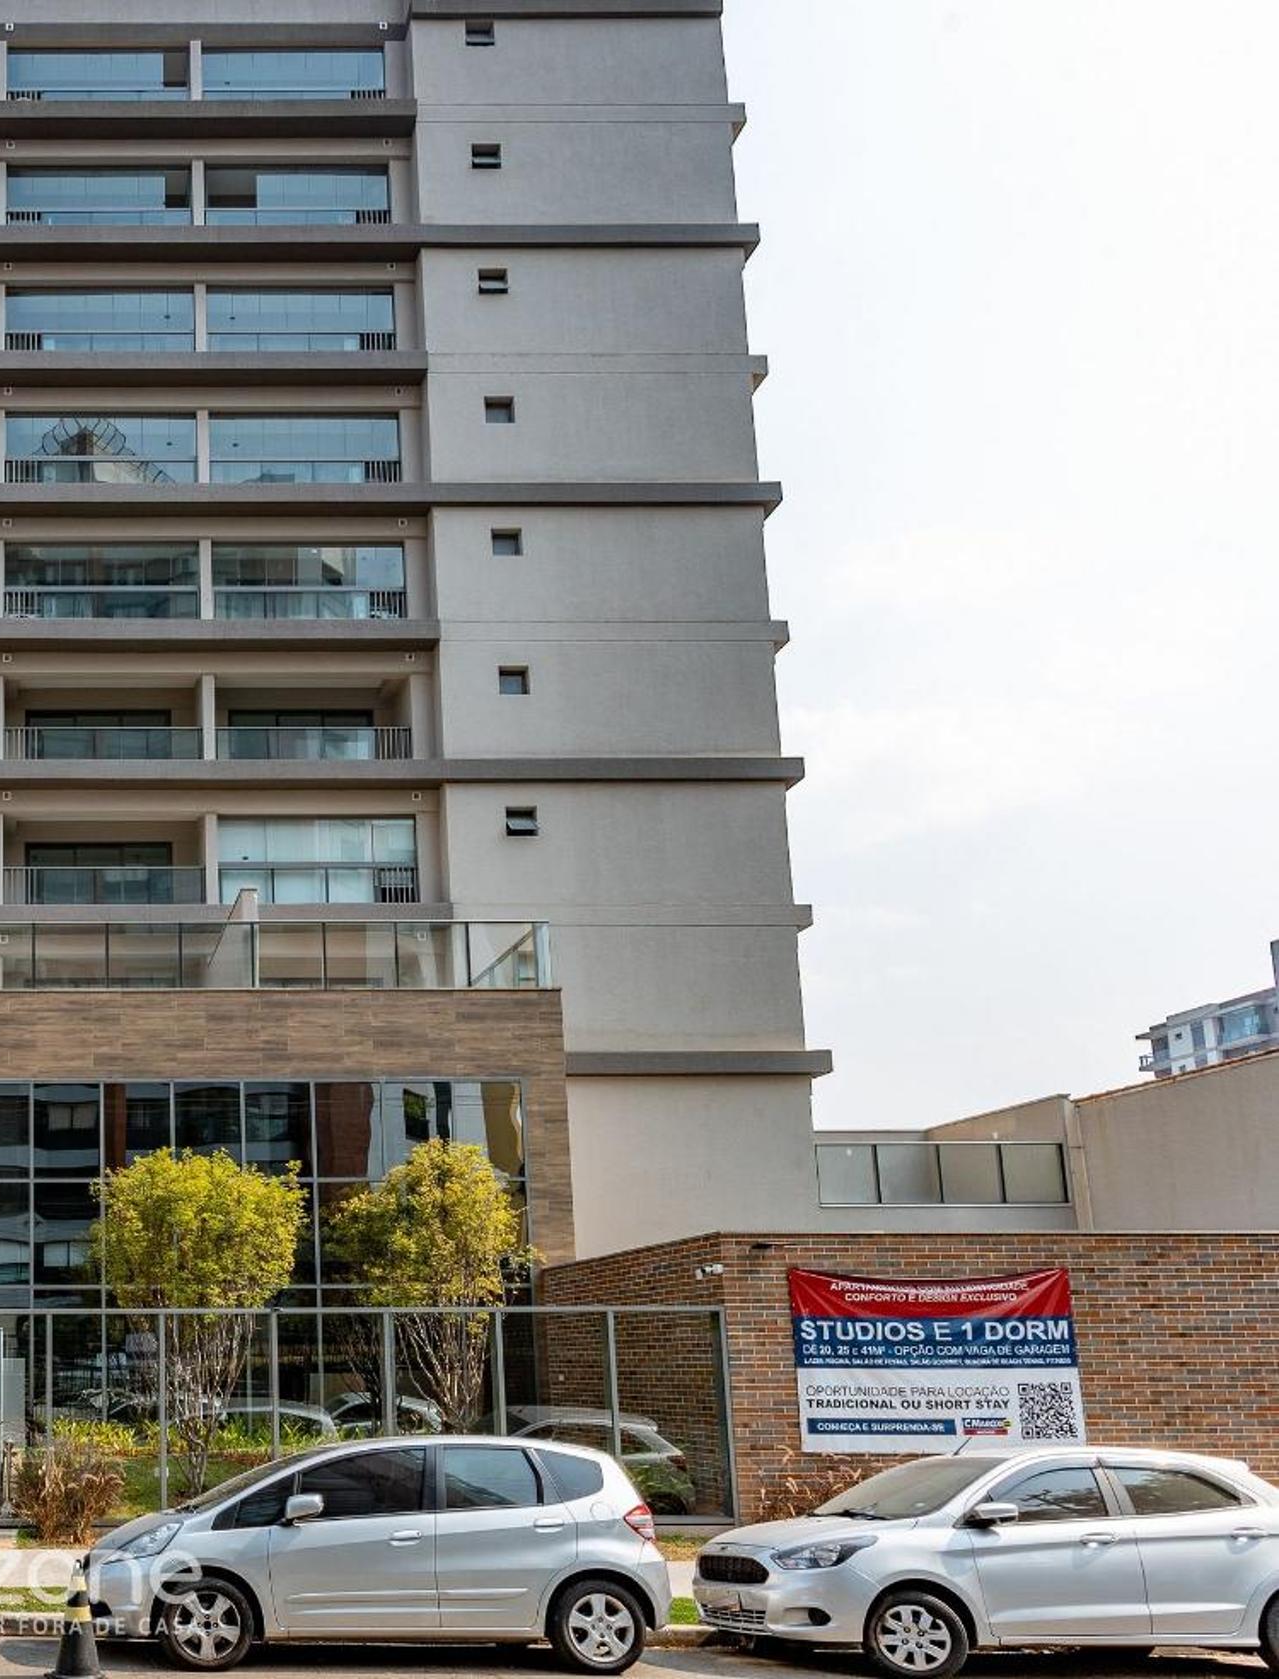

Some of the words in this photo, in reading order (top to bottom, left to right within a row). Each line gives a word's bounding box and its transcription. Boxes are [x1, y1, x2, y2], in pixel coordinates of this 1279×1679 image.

[845, 1292, 906, 1302] CONFORTO
[908, 1293, 916, 1303] E
[961, 1291, 1017, 1302] EXCLUSIVO
[800, 1320, 926, 1340] STUDIOS
[933, 1321, 952, 1341] E
[961, 1321, 973, 1340] 1
[984, 1319, 1069, 1341] DORM
[802, 1344, 818, 1355] DE
[837, 1345, 850, 1356] 25
[894, 1344, 934, 1358] OPÇÃO
[936, 1345, 963, 1356] COM
[964, 1345, 996, 1356] VAGA
[997, 1344, 1013, 1356] DE
[1014, 1343, 1070, 1355] GARAGEM
[806, 1385, 907, 1398] OPORTUNIDADE
[910, 1386, 946, 1397] PARA
[947, 1386, 1010, 1399] LOCAÇÃO
[807, 1398, 897, 1410] TRADICIONAL
[901, 1399, 921, 1410] OU
[925, 1399, 971, 1410] SHORT
[975, 1398, 1010, 1410] STAY
